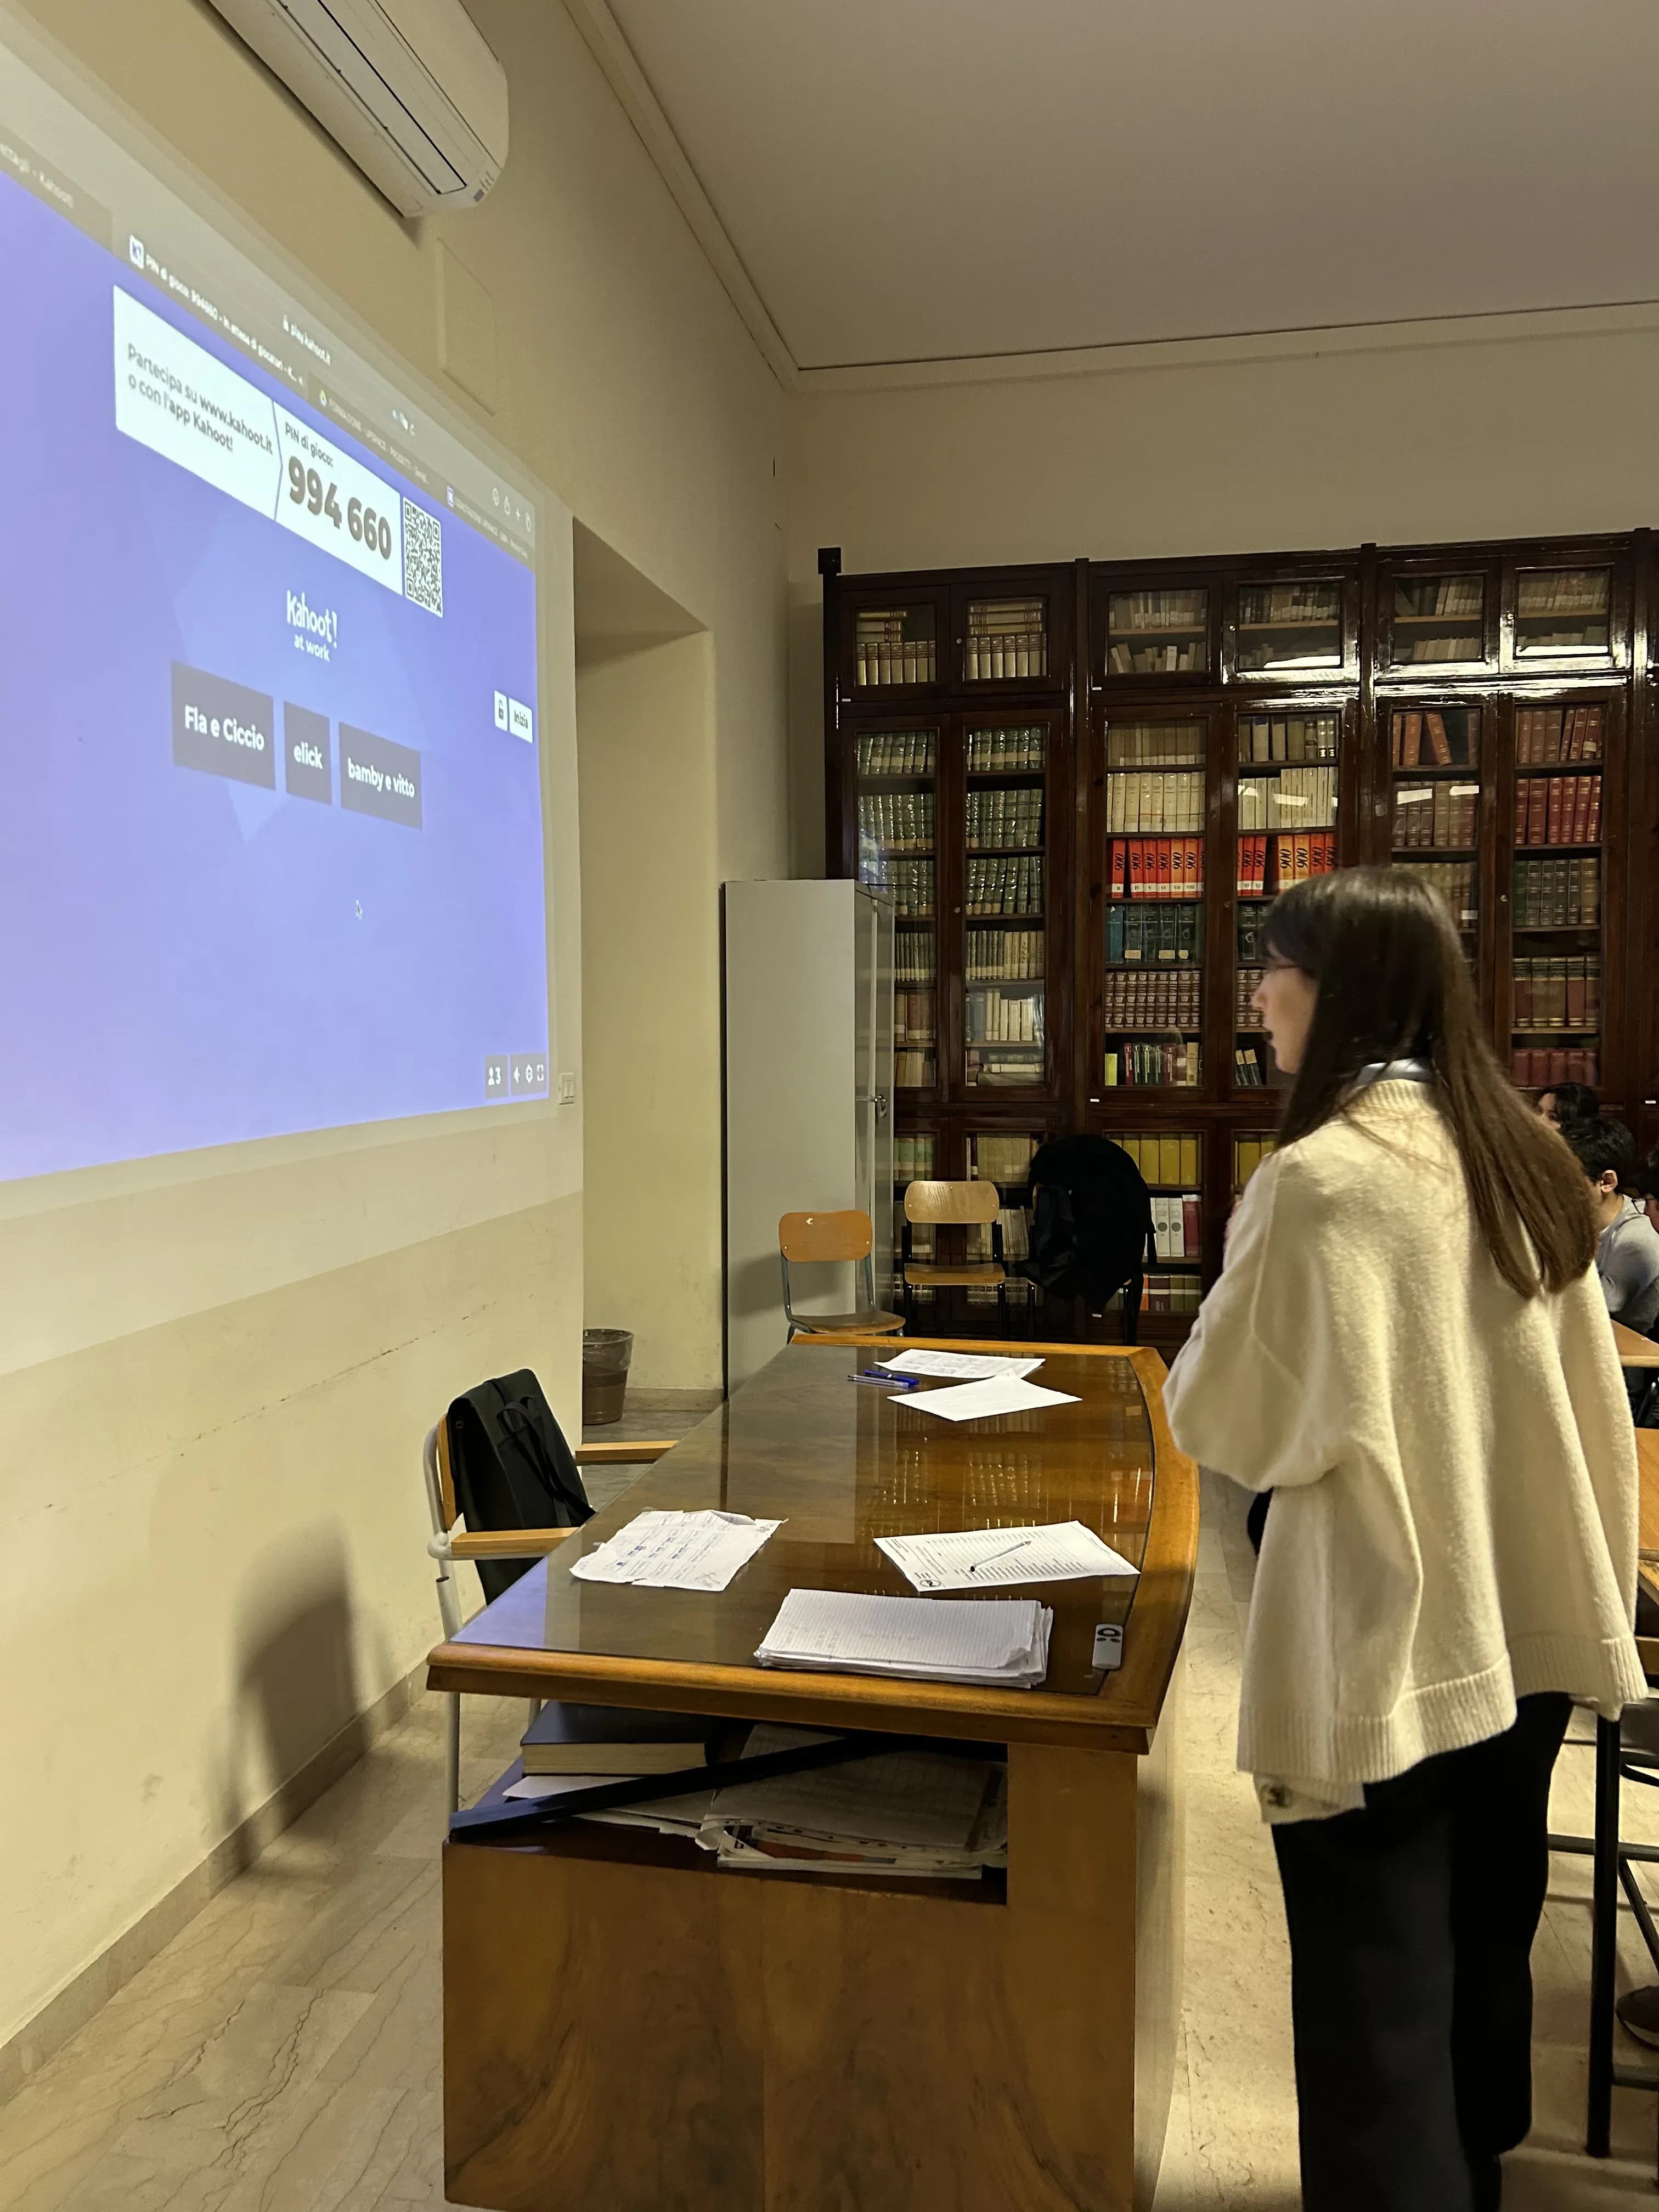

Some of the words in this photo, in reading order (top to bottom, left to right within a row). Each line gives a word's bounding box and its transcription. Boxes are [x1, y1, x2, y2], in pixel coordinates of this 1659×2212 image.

[128, 342, 182, 394] Partecipa
[185, 385, 198, 404] su
[200, 394, 273, 455] www.kahoot.it
[128, 374, 137, 390] o
[139, 380, 161, 406] con
[164, 390, 190, 426] l'app
[193, 410, 233, 453] Kahoot!
[285, 421, 299, 444] PIN
[301, 435, 309, 451] di
[311, 441, 334, 468] gioco:
[288, 455, 342, 530] 994
[347, 496, 392, 560] 660
[286, 589, 338, 649] Kahoot!
[294, 634, 305, 652] at
[305, 639, 330, 663] work
[184, 703, 207, 735] Fla
[210, 718, 221, 737] e
[223, 718, 265, 751] Ciccio
[514, 709, 529, 730] Inizia
[294, 740, 323, 770] elick
[347, 756, 384, 792] bamby
[385, 775, 392, 791] e
[393, 772, 415, 798] vitto
[1114, 853, 1125, 871] 900
[1131, 852, 1142, 870] 900
[1145, 852, 1155, 871] 900
[1158, 852, 1169, 871] 900
[1172, 851, 1183, 870] 900
[1186, 851, 1197, 870] 900
[1242, 849, 1252, 868] 900
[1254, 849, 1265, 868] 900
[1280, 848, 1292, 869] 900
[1296, 847, 1308, 868] 900
[1311, 846, 1323, 867] 900
[495, 1066, 501, 1085] 3
